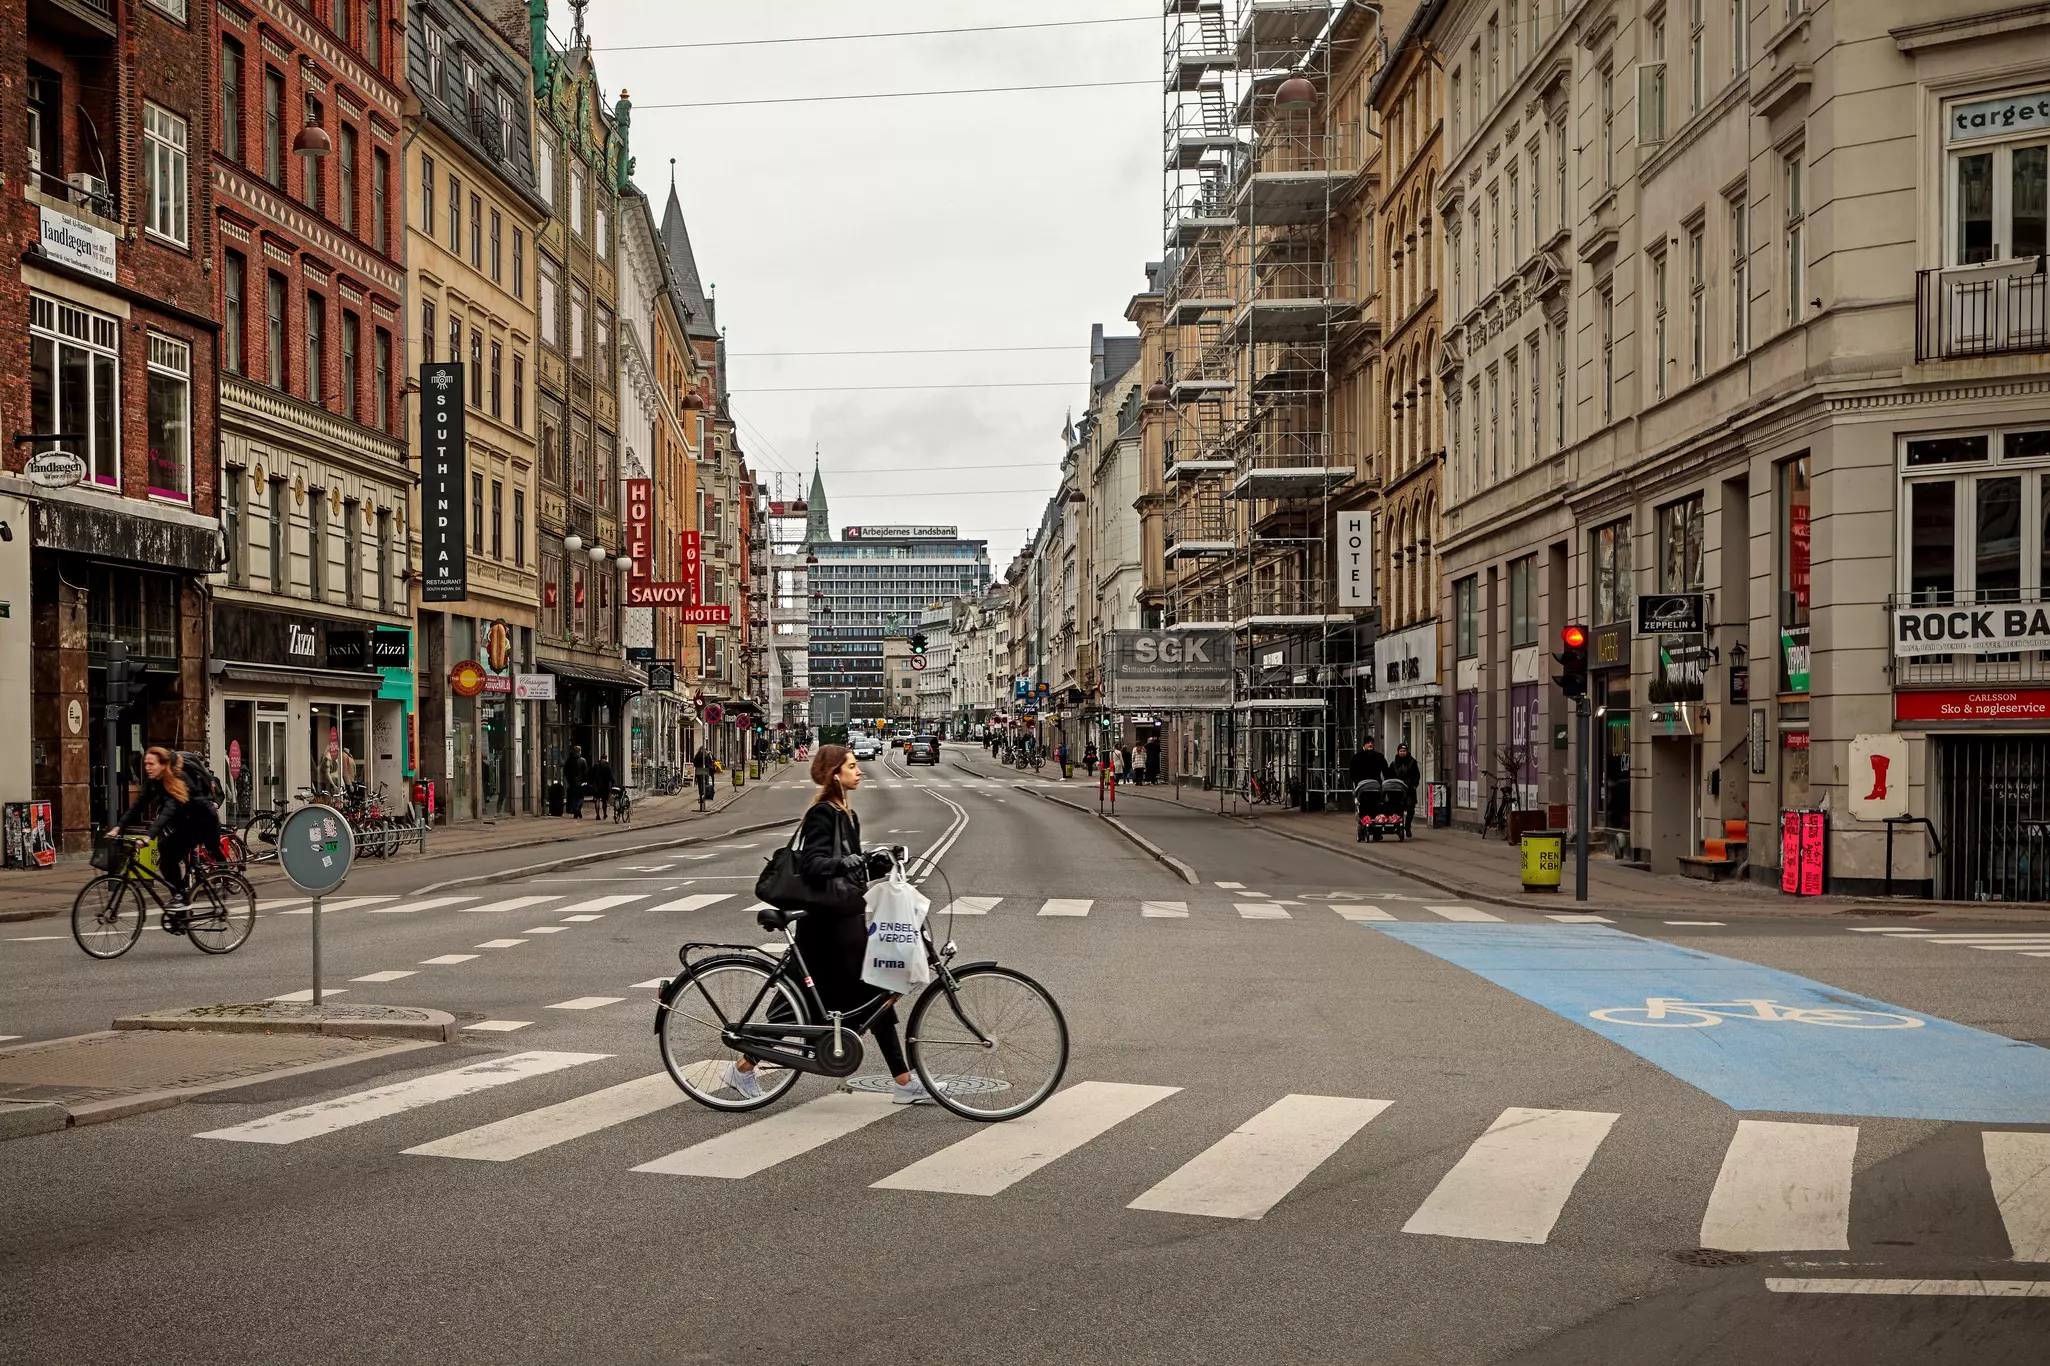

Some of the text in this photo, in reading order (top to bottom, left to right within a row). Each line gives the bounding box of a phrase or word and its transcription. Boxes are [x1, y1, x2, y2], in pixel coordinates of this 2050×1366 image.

[1956, 101, 2049, 129] target
[42, 219, 92, 256] Tandlægen
[28, 462, 81, 474] Tandlægen
[632, 484, 646, 577] HOTEL
[862, 528, 910, 537] Arbejdernes
[914, 528, 956, 536] Landsbank
[1349, 519, 1361, 598] HOTEL
[631, 588, 686, 603] SAVOY
[685, 609, 728, 621] HOTEL
[1644, 620, 1688, 630] ZEPPELIN
[1899, 611, 1995, 642] ROCK
[289, 624, 315, 656] Zizzi
[376, 643, 405, 655] Zizzi
[1135, 637, 1210, 663] SGK
[1968, 693, 2017, 702] CARLSSON
[1941, 702, 2046, 716] Sko & nøgleservice
[1540, 852, 1559, 860] REN
[1540, 862, 1559, 870] KBH
[873, 957, 905, 969] Irma
